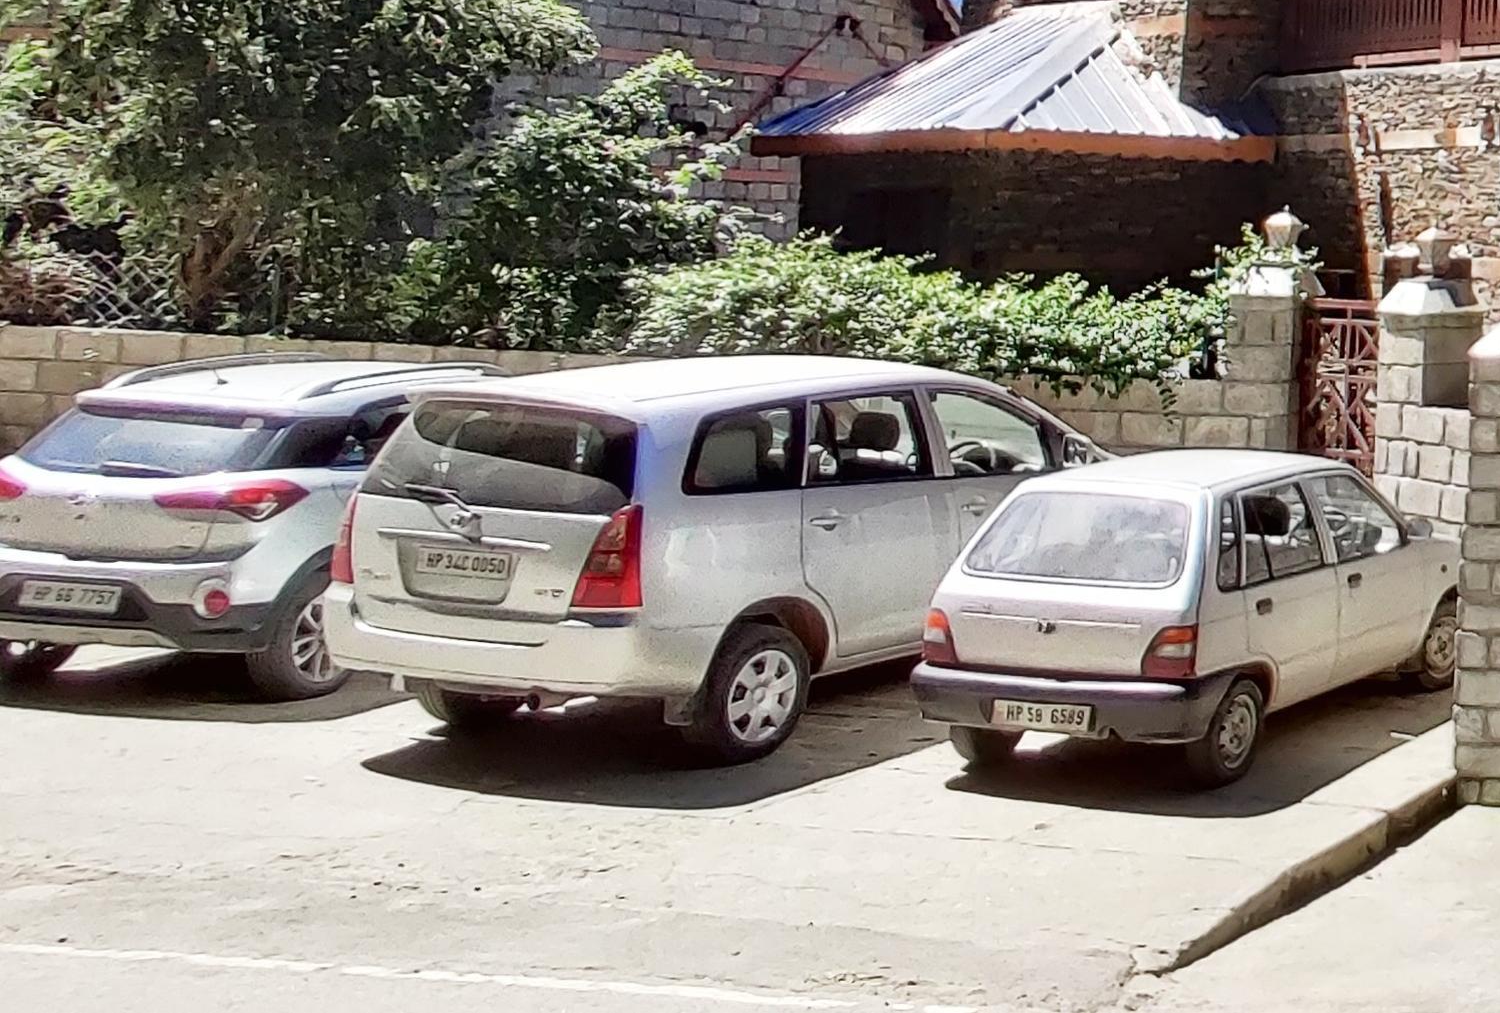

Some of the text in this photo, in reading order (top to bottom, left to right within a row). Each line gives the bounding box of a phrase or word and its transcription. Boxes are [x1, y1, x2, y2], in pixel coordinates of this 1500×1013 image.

[426, 553, 443, 568] HP
[471, 556, 506, 574] 0050
[1006, 705, 1085, 726] HP 58 6589
